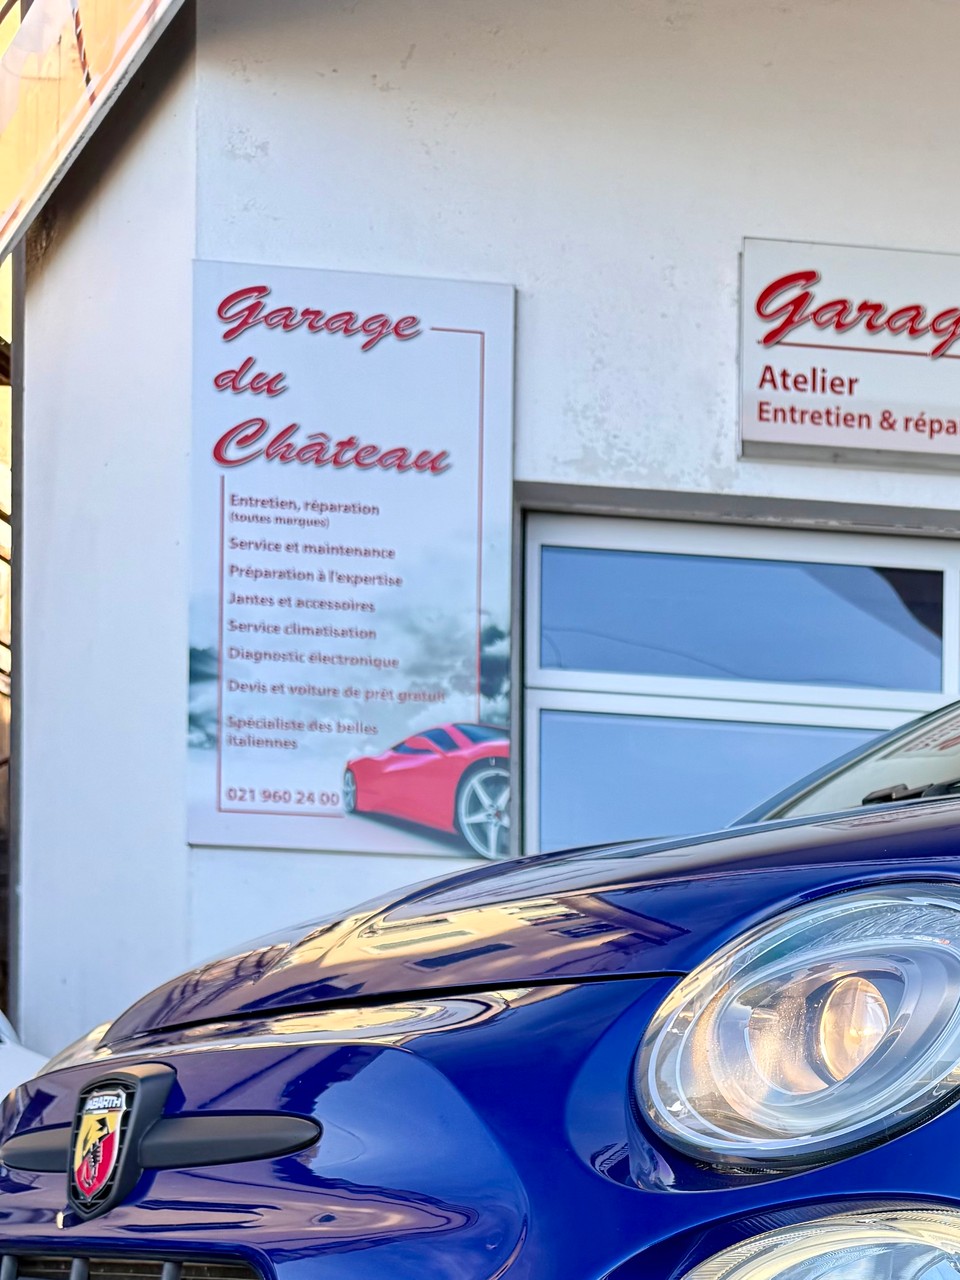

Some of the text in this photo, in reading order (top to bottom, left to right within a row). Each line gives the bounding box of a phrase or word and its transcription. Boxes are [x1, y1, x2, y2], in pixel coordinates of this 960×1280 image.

[216, 285, 423, 352] Garage
[213, 356, 287, 396] du
[758, 365, 859, 396] Atelier
[757, 401, 872, 431] Entretien
[880, 409, 898, 432] &
[211, 417, 452, 474] Château
[229, 494, 380, 515] Entretien, réparation
[229, 512, 330, 529] (toutes marques)
[228, 537, 396, 559] Service et maintenance
[228, 564, 314, 581] Préparation
[316, 569, 326, 583] à
[227, 592, 376, 613] Jantes et accessoires
[227, 619, 377, 640] Service climatisation
[227, 647, 400, 670] Diagnostic électronique
[227, 679, 446, 704] Devis et voiture de prêt gratuit
[226, 715, 378, 736] Spécialiste des belles
[227, 733, 298, 750] italiennes
[226, 787, 340, 807] 021 960 24 00
[86, 1095, 121, 1110] ABARTH
